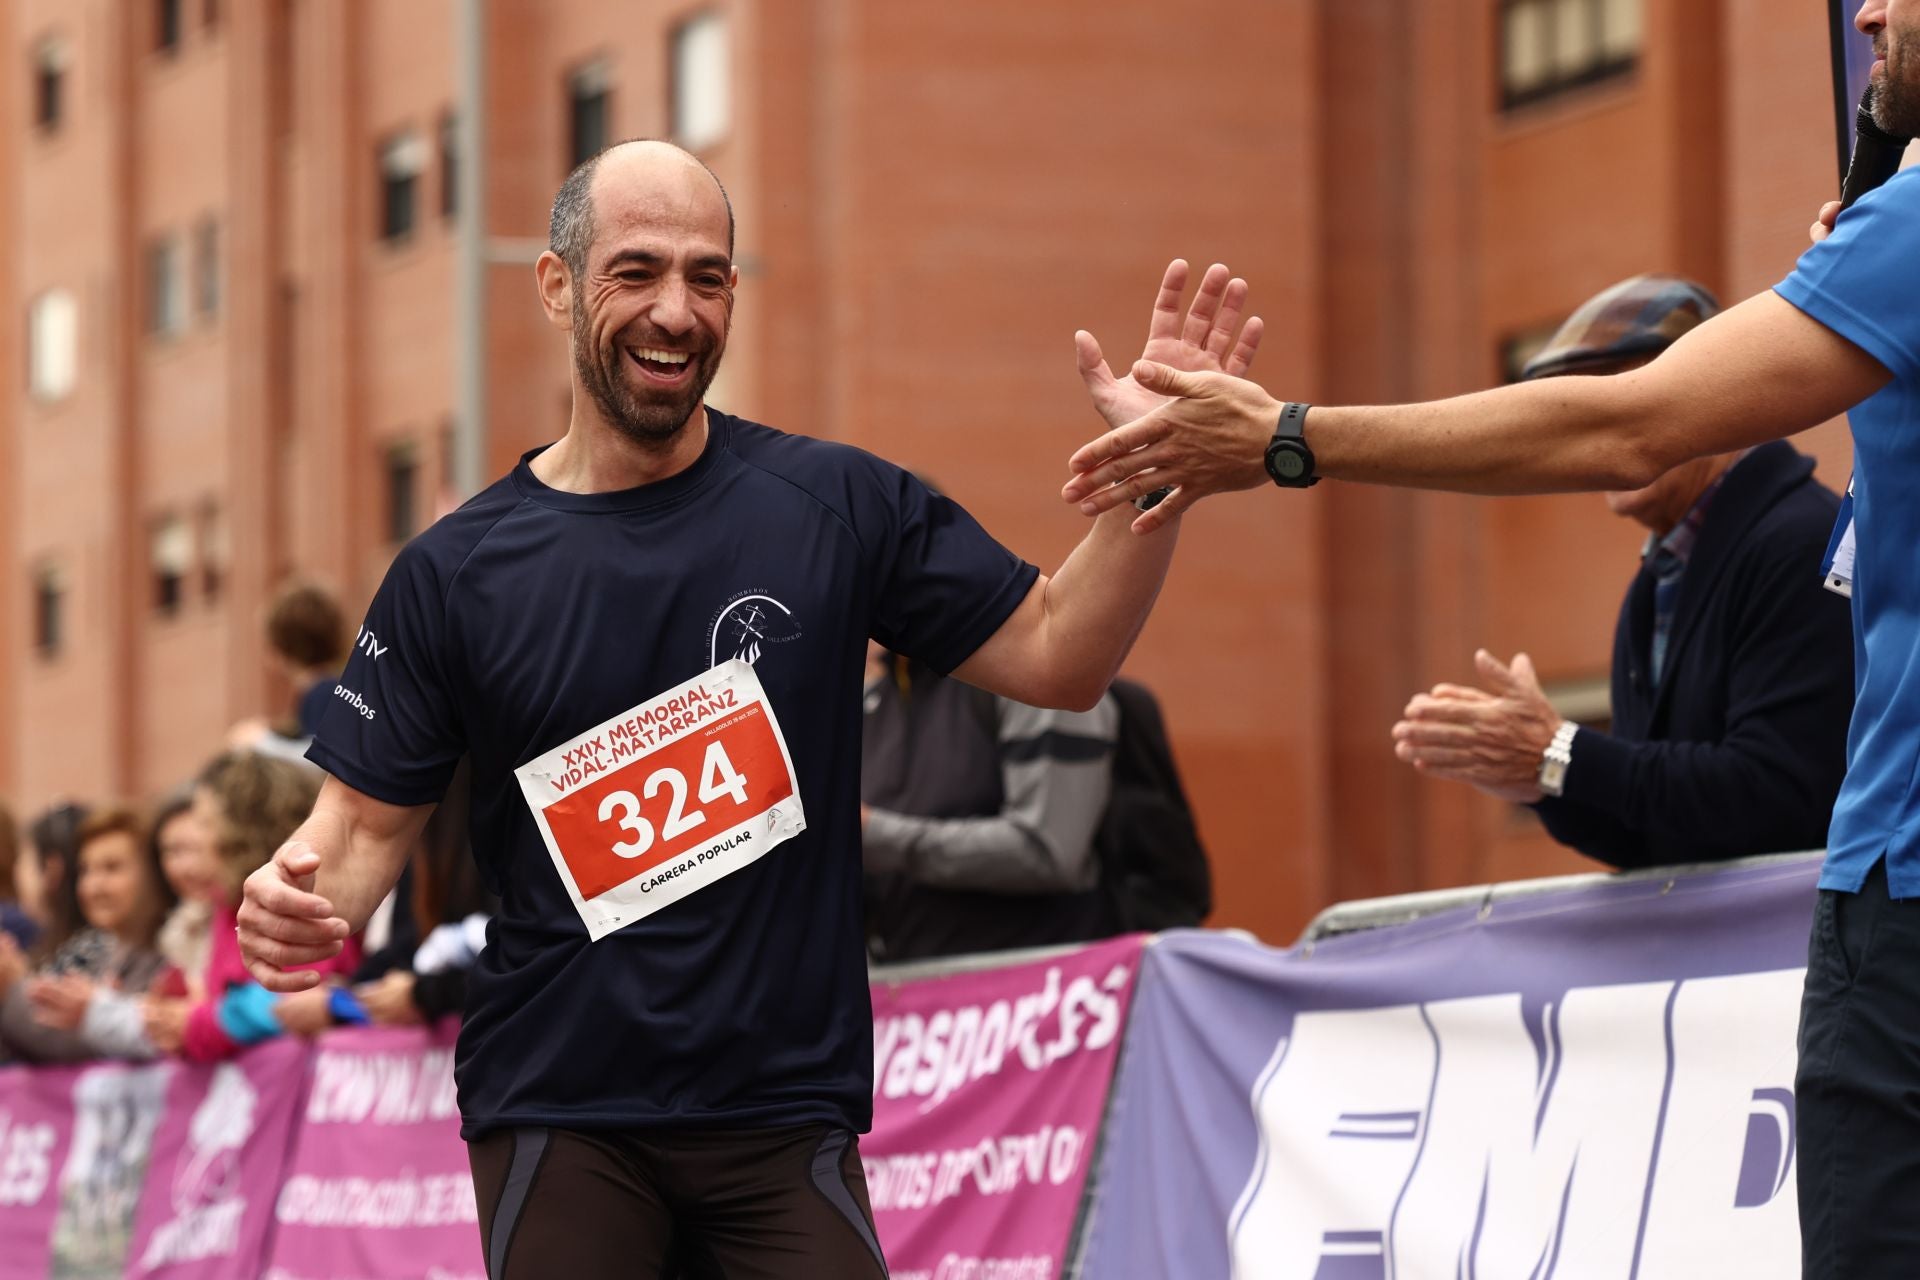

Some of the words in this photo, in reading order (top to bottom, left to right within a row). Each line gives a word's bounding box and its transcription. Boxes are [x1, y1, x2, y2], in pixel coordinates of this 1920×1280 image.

[551, 688, 739, 792] VIDAL-MATARRANZ
[561, 735, 606, 770] XXIX
[608, 684, 712, 747] MEMORIAL
[704, 718, 734, 737] VALLADOLID
[597, 740, 749, 860] 324
[640, 859, 697, 894] CARRERA
[697, 830, 753, 865] POPULAR
